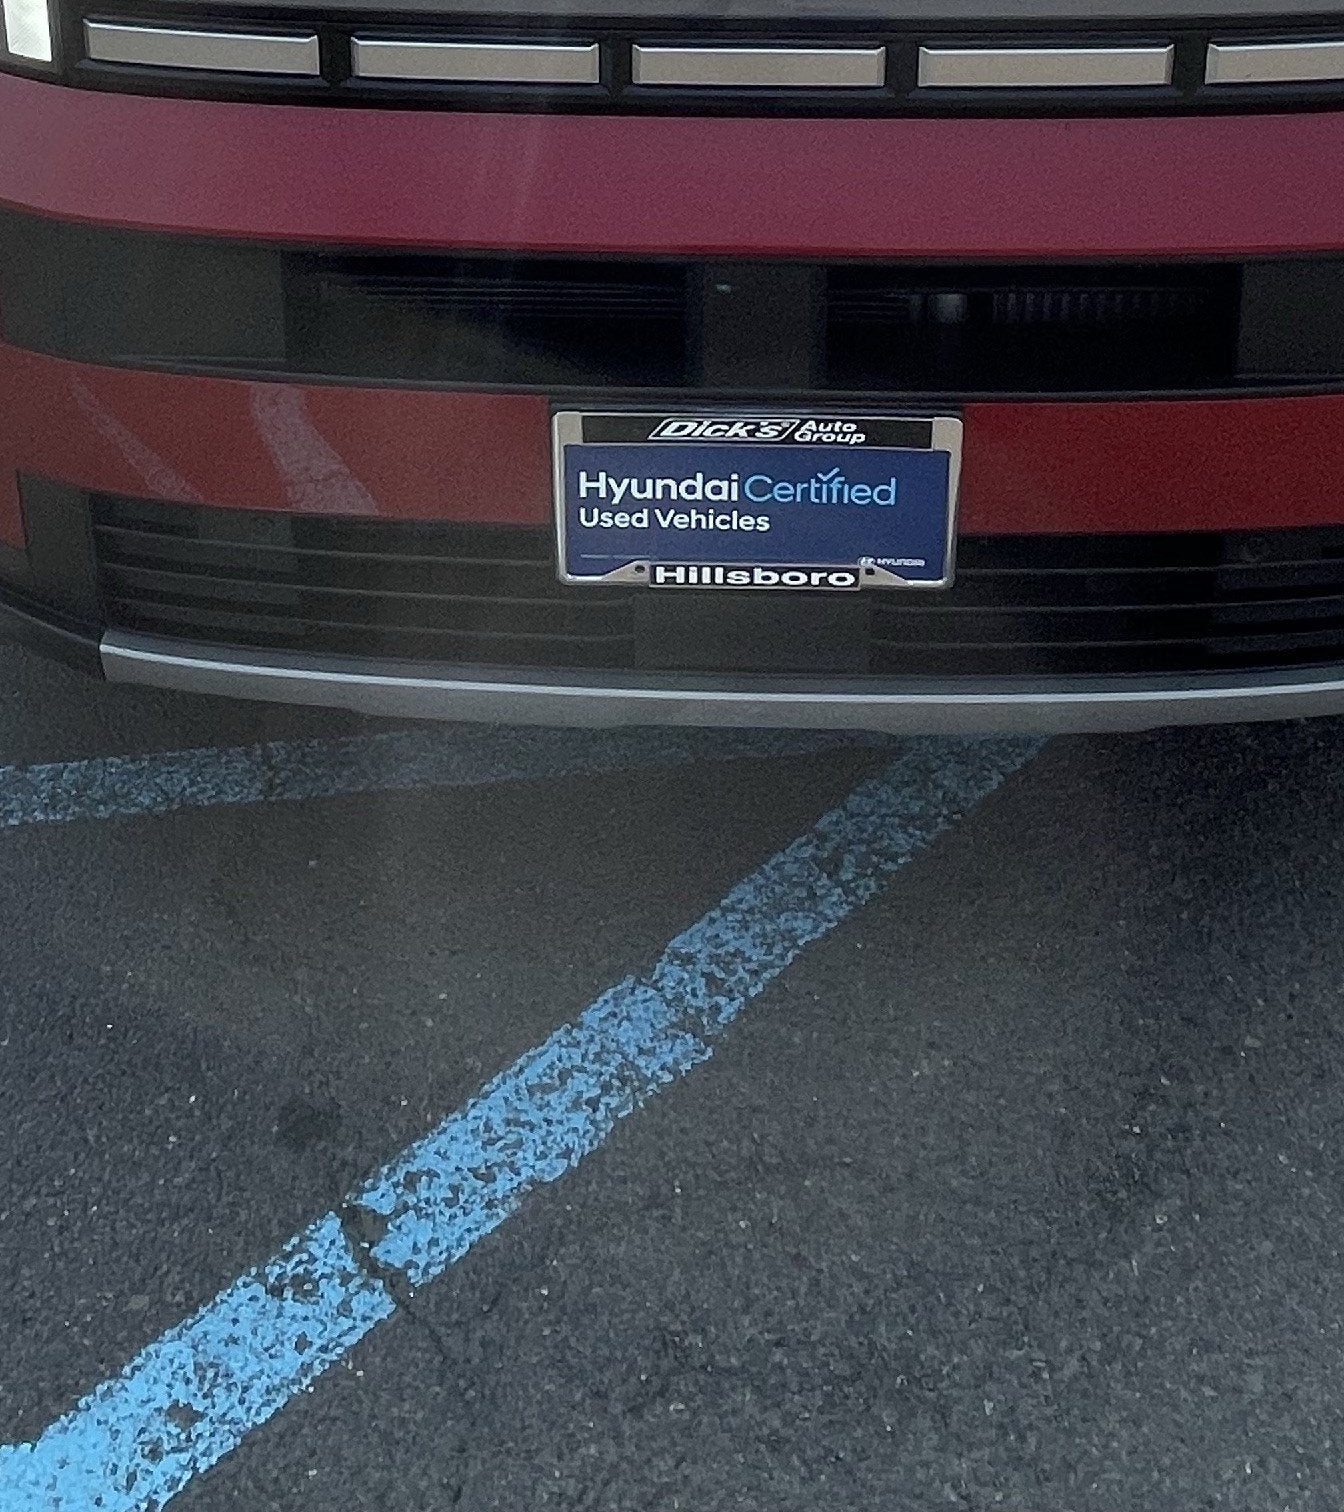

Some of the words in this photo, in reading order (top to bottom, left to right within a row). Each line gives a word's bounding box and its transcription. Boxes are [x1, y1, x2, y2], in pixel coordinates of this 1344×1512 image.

[801, 419, 857, 433] Auto
[794, 431, 866, 445] Group
[578, 471, 739, 505] Hyundai
[744, 471, 897, 506] Certified
[579, 508, 649, 529] Used
[655, 508, 771, 532] Vehicles
[655, 566, 856, 587] Hillsboro
